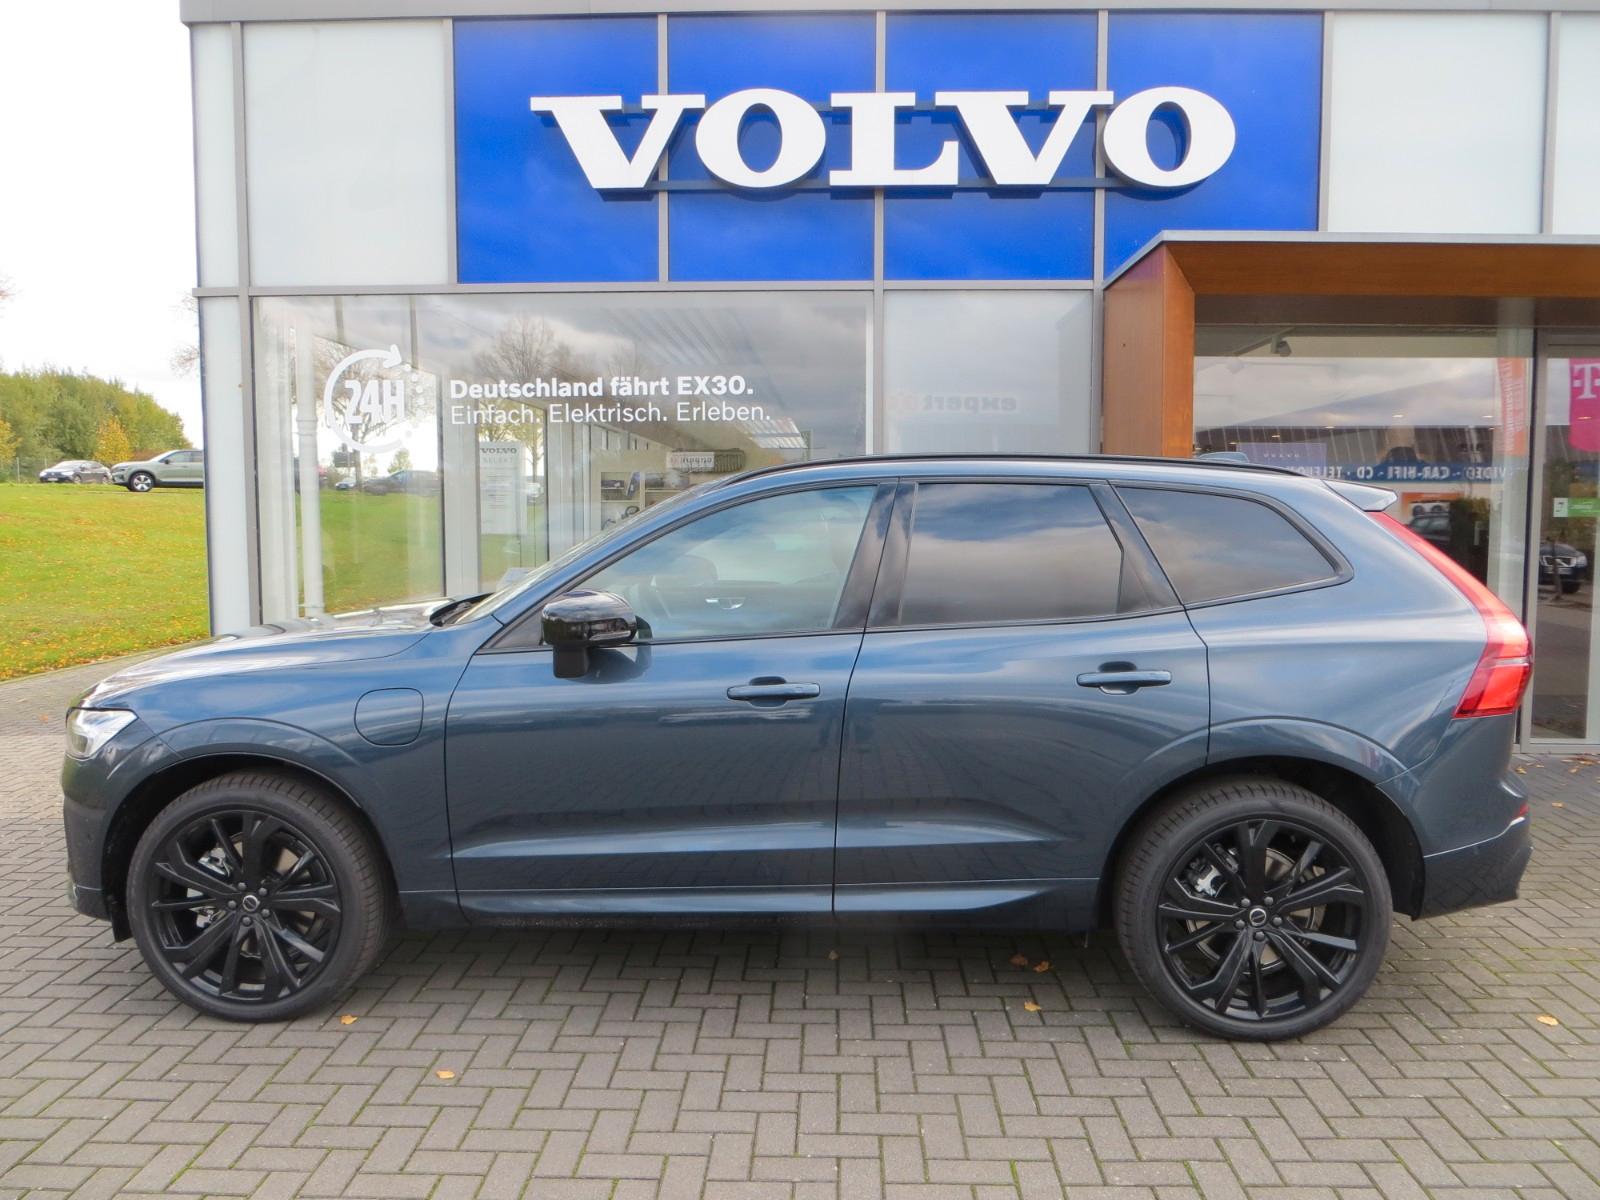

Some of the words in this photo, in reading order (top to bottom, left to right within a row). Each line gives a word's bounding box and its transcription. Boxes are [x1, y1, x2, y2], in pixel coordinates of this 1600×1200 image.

[530, 86, 1236, 190] VOLVO
[344, 379, 405, 424] 24H
[450, 377, 603, 399] Deutschland
[610, 376, 670, 396] fährt
[677, 375, 754, 395] EX30.
[451, 403, 541, 425] Einfach.
[550, 402, 668, 423] Elektrisch.
[676, 401, 771, 422] Erleben.
